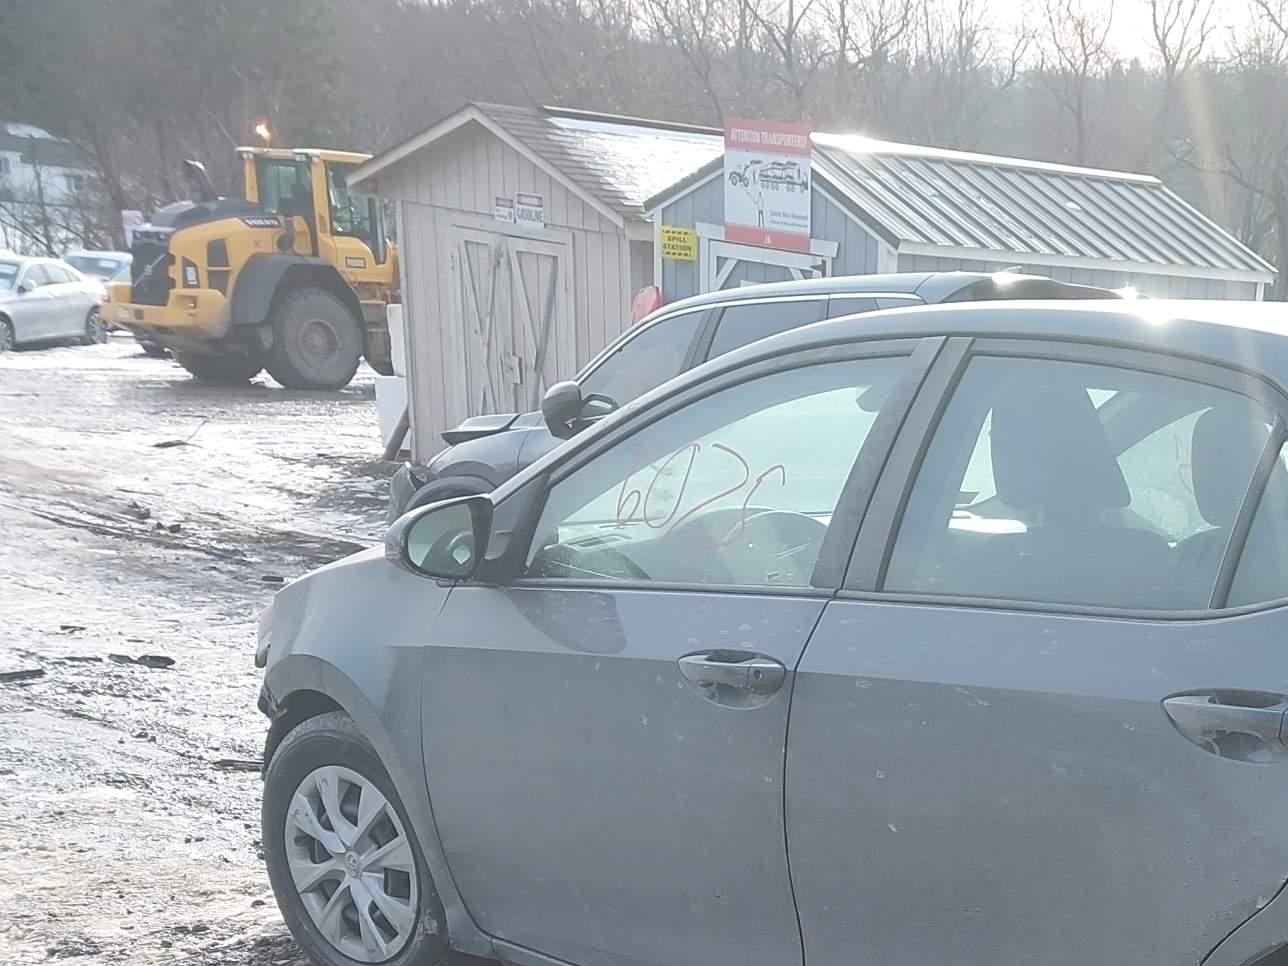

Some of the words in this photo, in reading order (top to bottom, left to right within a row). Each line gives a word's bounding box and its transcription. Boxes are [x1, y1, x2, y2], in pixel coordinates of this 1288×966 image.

[730, 128, 760, 144] ATTENTION
[516, 207, 543, 222] GASOLINE
[667, 235, 687, 243] SPILL
[663, 243, 692, 252] STATION
